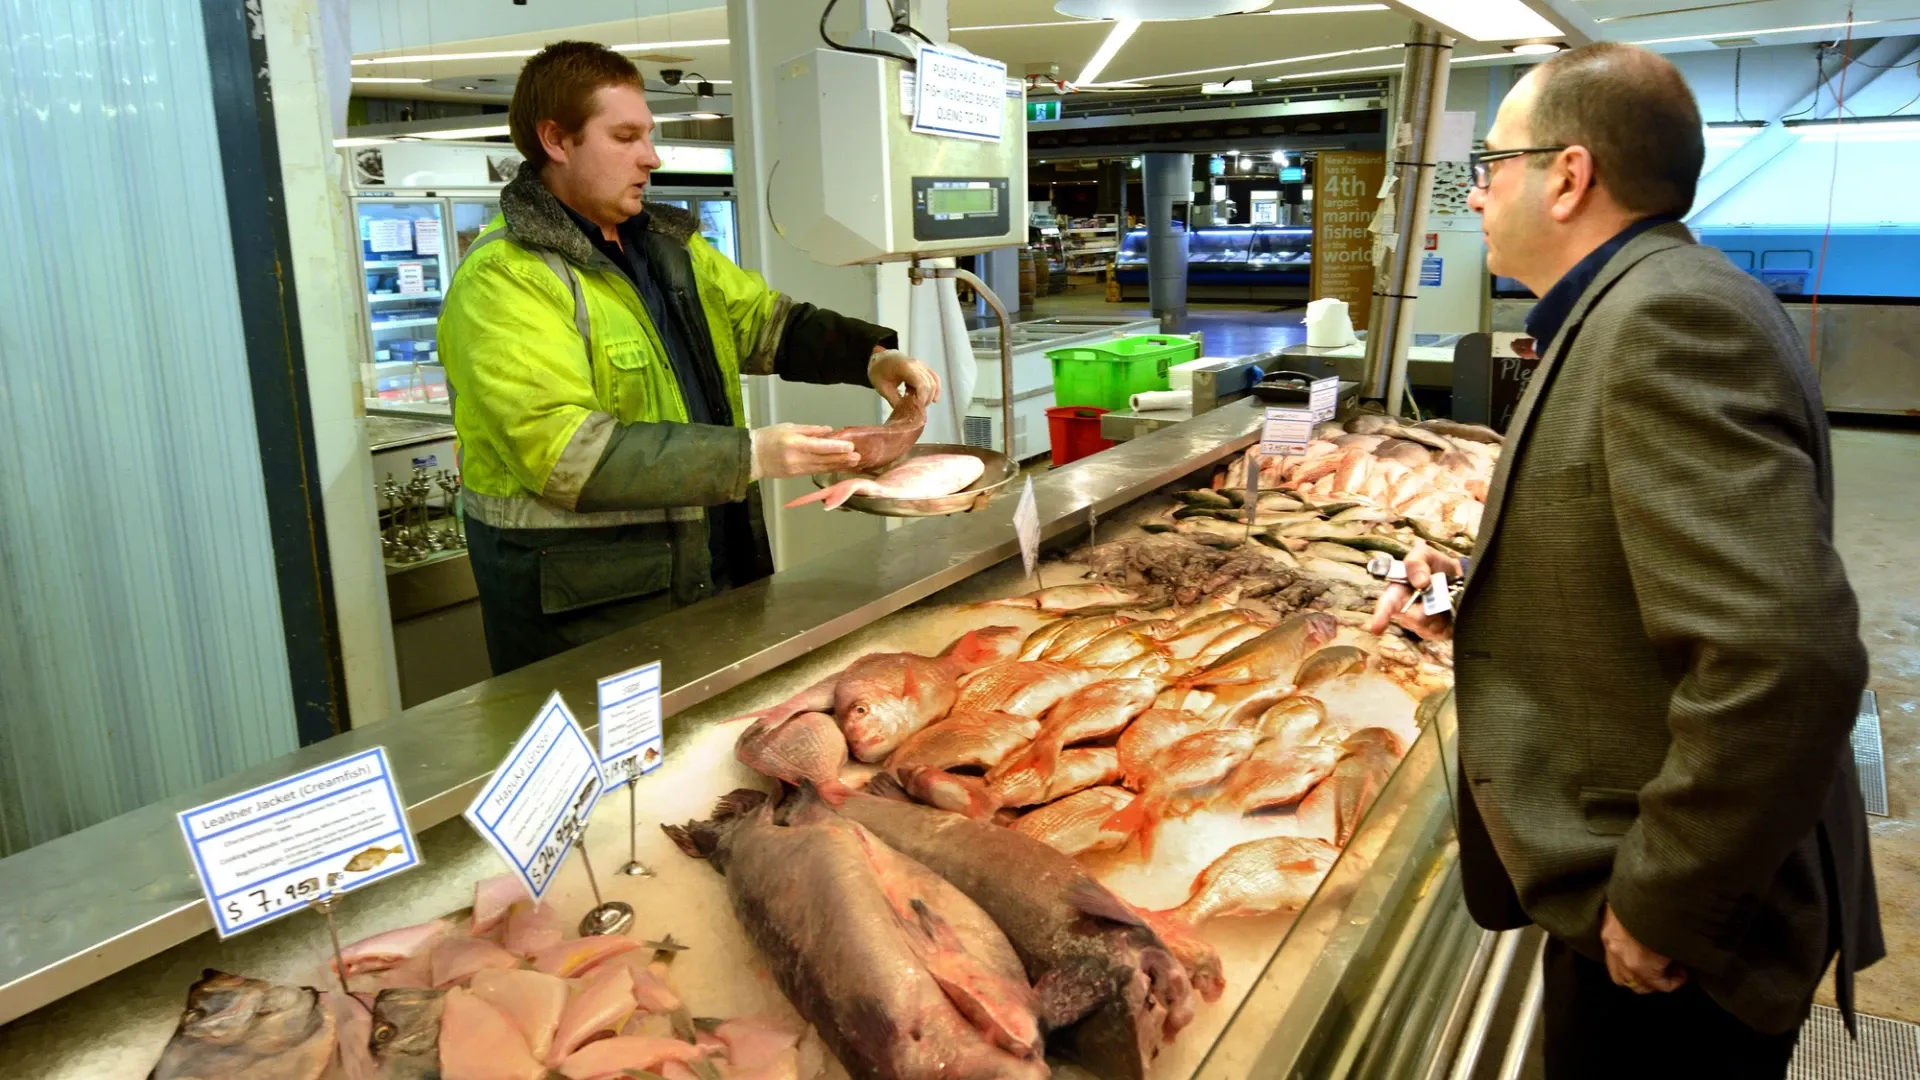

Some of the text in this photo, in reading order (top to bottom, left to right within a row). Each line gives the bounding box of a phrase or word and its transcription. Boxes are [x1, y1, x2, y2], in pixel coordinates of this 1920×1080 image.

[933, 63, 957, 80] PLEASE
[959, 70, 977, 84] HAVE
[925, 83, 941, 97] FISH
[944, 87, 975, 104] WEIGHED
[976, 93, 1000, 109] BEFORE
[964, 111, 975, 124] TO
[976, 113, 988, 124] PAY
[1324, 155, 1382, 165] New Zealand
[1324, 165, 1356, 174] has the
[1324, 175, 1366, 197] 4th
[1323, 198, 1359, 209] largest
[1323, 224, 1369, 240] fisher
[1332, 240, 1347, 249] the
[1500, 359, 1531, 381] Ple
[495, 767, 525, 807] Hapuka
[202, 806, 252, 830] Leather
[256, 790, 297, 812] Jacket
[299, 764, 372, 798] (Creamfish)
[532, 870, 541, 885] $
[227, 901, 243, 922] $
